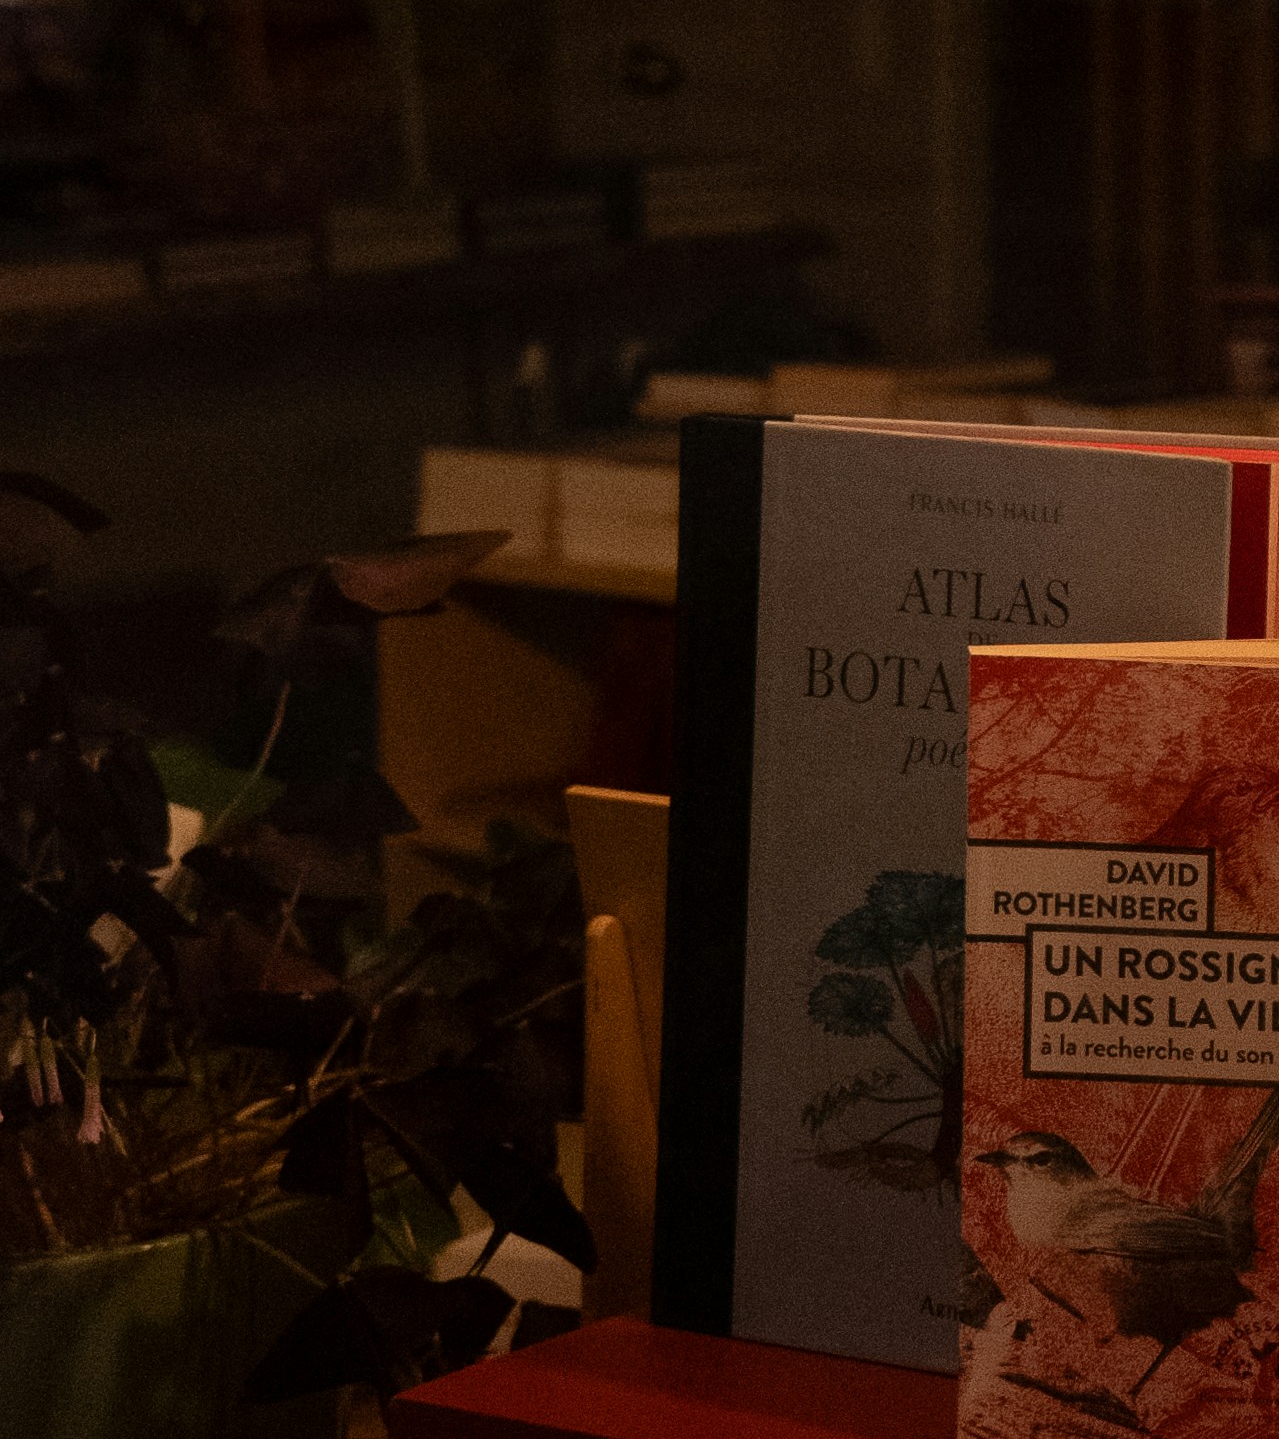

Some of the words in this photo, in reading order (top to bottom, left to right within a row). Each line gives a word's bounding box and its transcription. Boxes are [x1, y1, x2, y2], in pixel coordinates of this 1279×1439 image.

[909, 492, 995, 519] FRANCIS
[897, 567, 1071, 629] ATLAS
[1107, 859, 1200, 888] DAVID
[993, 890, 1200, 923] ROTHENBERG
[1044, 943, 1103, 978] UN
[1044, 991, 1156, 1028] DANS
[1168, 995, 1215, 1030] LA
[1040, 1032, 1054, 1056] à
[1060, 1033, 1077, 1057] la
[1085, 1035, 1195, 1062] recherche
[1201, 1038, 1230, 1065] du
[1236, 1044, 1275, 1067] son
